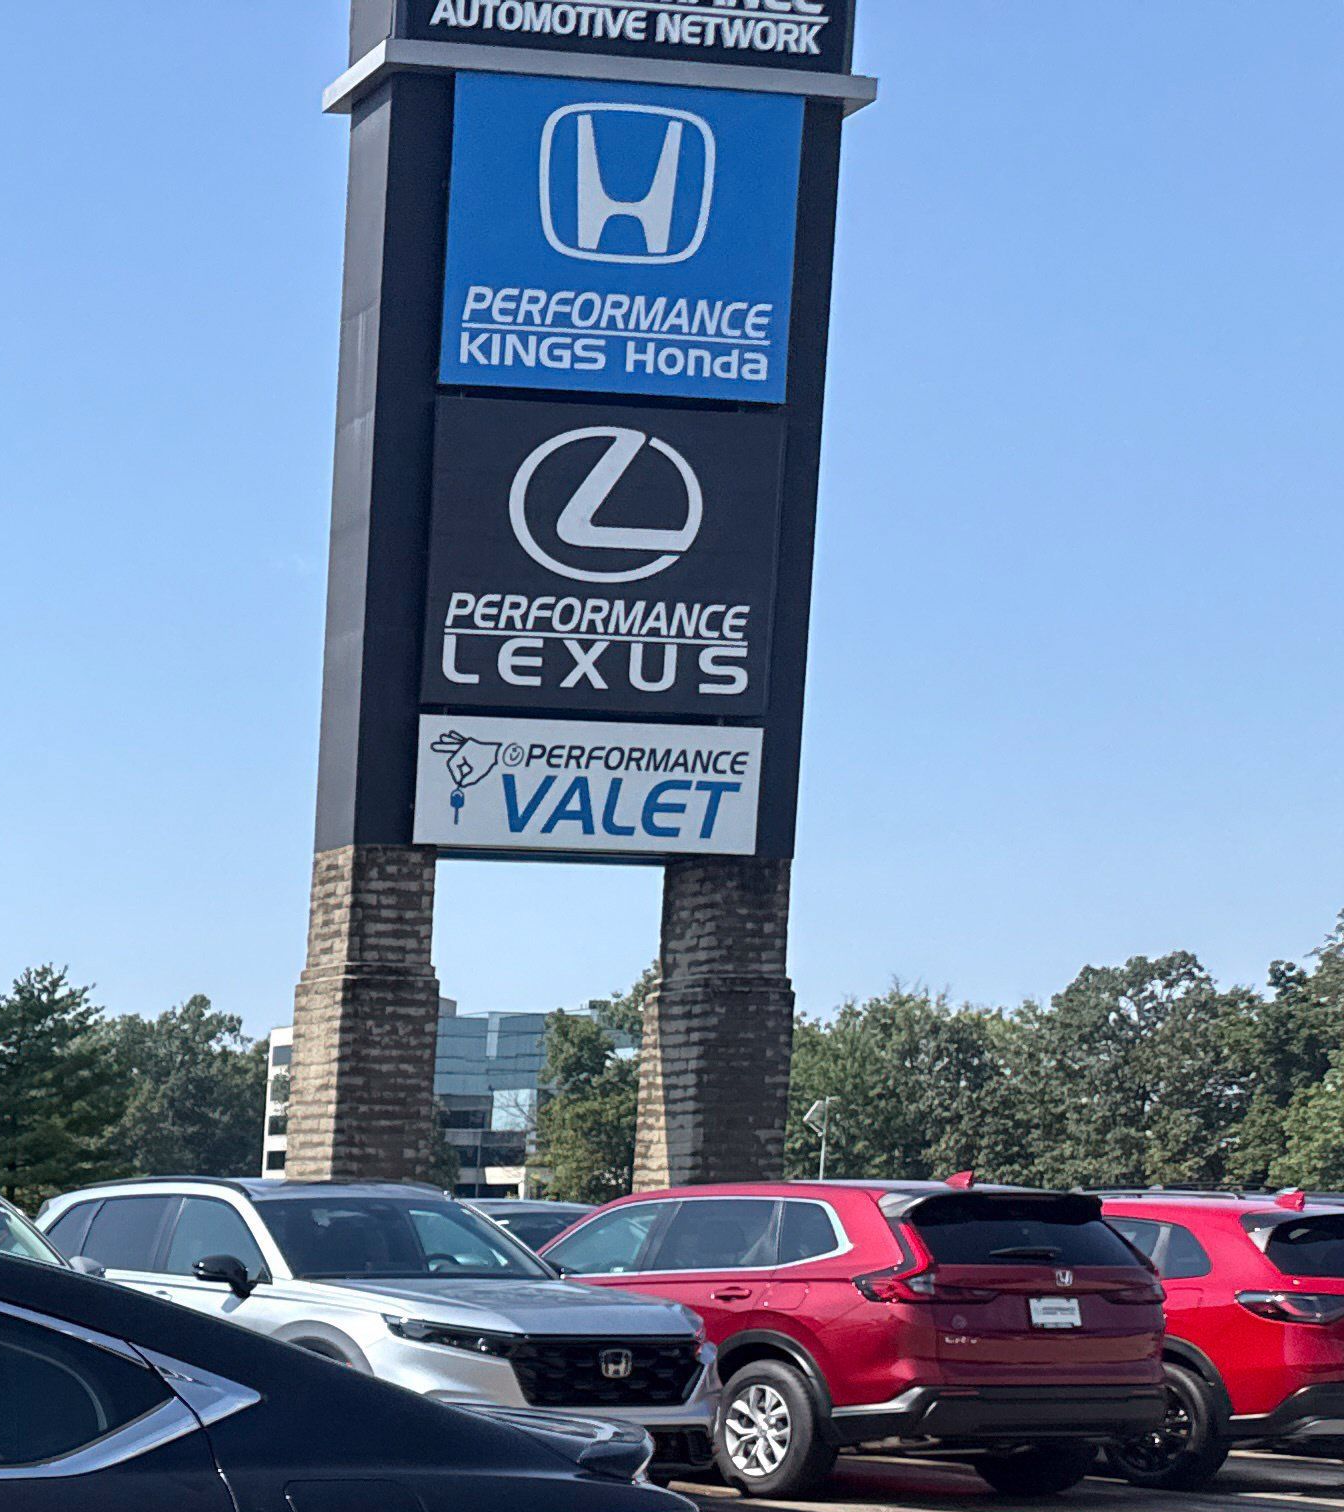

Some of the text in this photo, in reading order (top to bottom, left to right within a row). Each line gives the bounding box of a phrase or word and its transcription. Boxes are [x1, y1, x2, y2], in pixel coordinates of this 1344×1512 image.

[429, 0, 823, 54] AUTOMOTIVE NETWORK
[462, 286, 773, 338] PERFORMANCE
[459, 333, 768, 381] KINGS Honda
[445, 592, 750, 639] PERFORMANCE
[442, 635, 748, 694] LEXUS
[525, 743, 749, 775] PERFORMANCE
[501, 773, 741, 839] VALET
